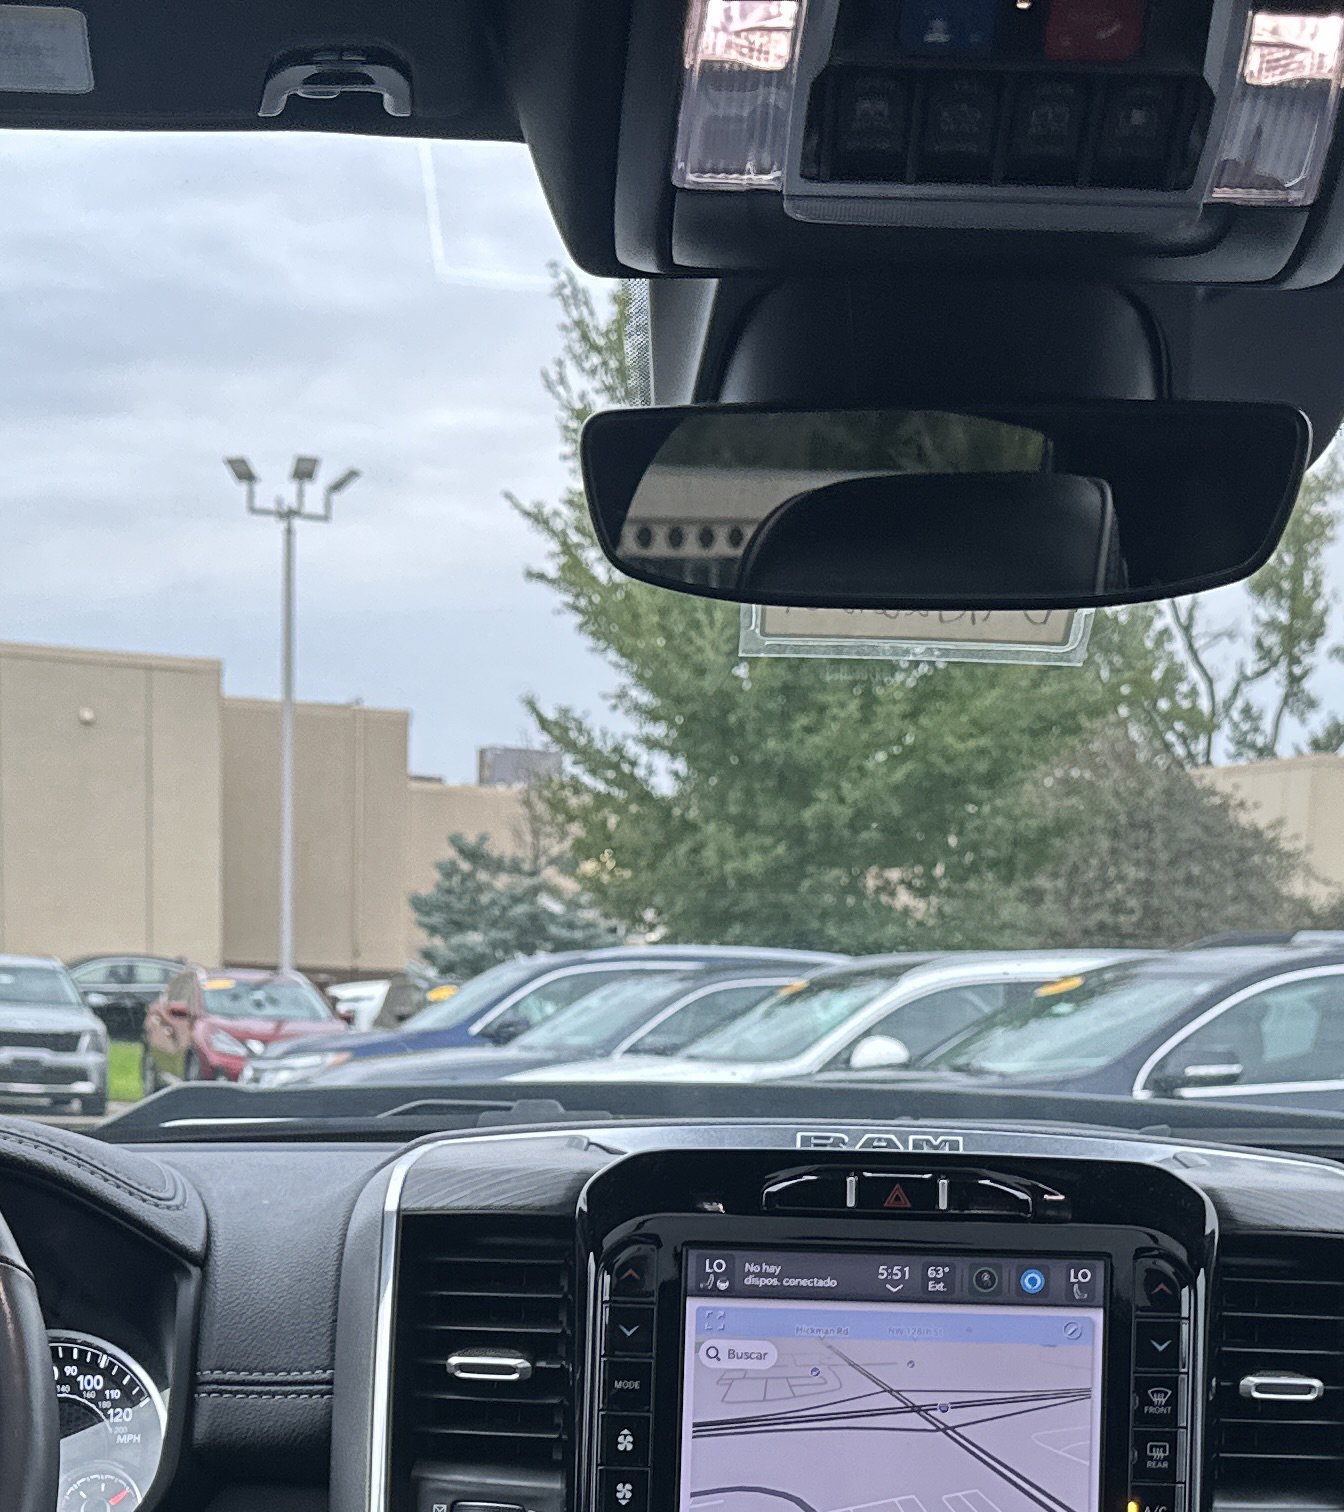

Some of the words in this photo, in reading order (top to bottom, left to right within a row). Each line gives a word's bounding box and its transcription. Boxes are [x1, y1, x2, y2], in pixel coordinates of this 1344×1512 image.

[796, 1132, 963, 1152] RAM
[704, 1258, 727, 1274] LO
[744, 1263, 760, 1274] No
[762, 1262, 781, 1276] hay
[927, 1266, 950, 1279] 63°
[877, 1265, 911, 1281] 5:51
[1070, 1268, 1092, 1283] LO
[783, 1276, 838, 1289] conectado
[836, 1327, 849, 1336] Rd
[727, 1348, 769, 1362] Buscar
[64, 1366, 78, 1376] 90
[76, 1375, 103, 1390] 100
[614, 1380, 641, 1390] MODE
[82, 1391, 96, 1399] 160
[105, 1389, 121, 1399] 110
[108, 1408, 133, 1423] 120
[1144, 1406, 1172, 1415] FRONT
[116, 1434, 142, 1444] MPH
[1146, 1461, 1168, 1469] REAR
